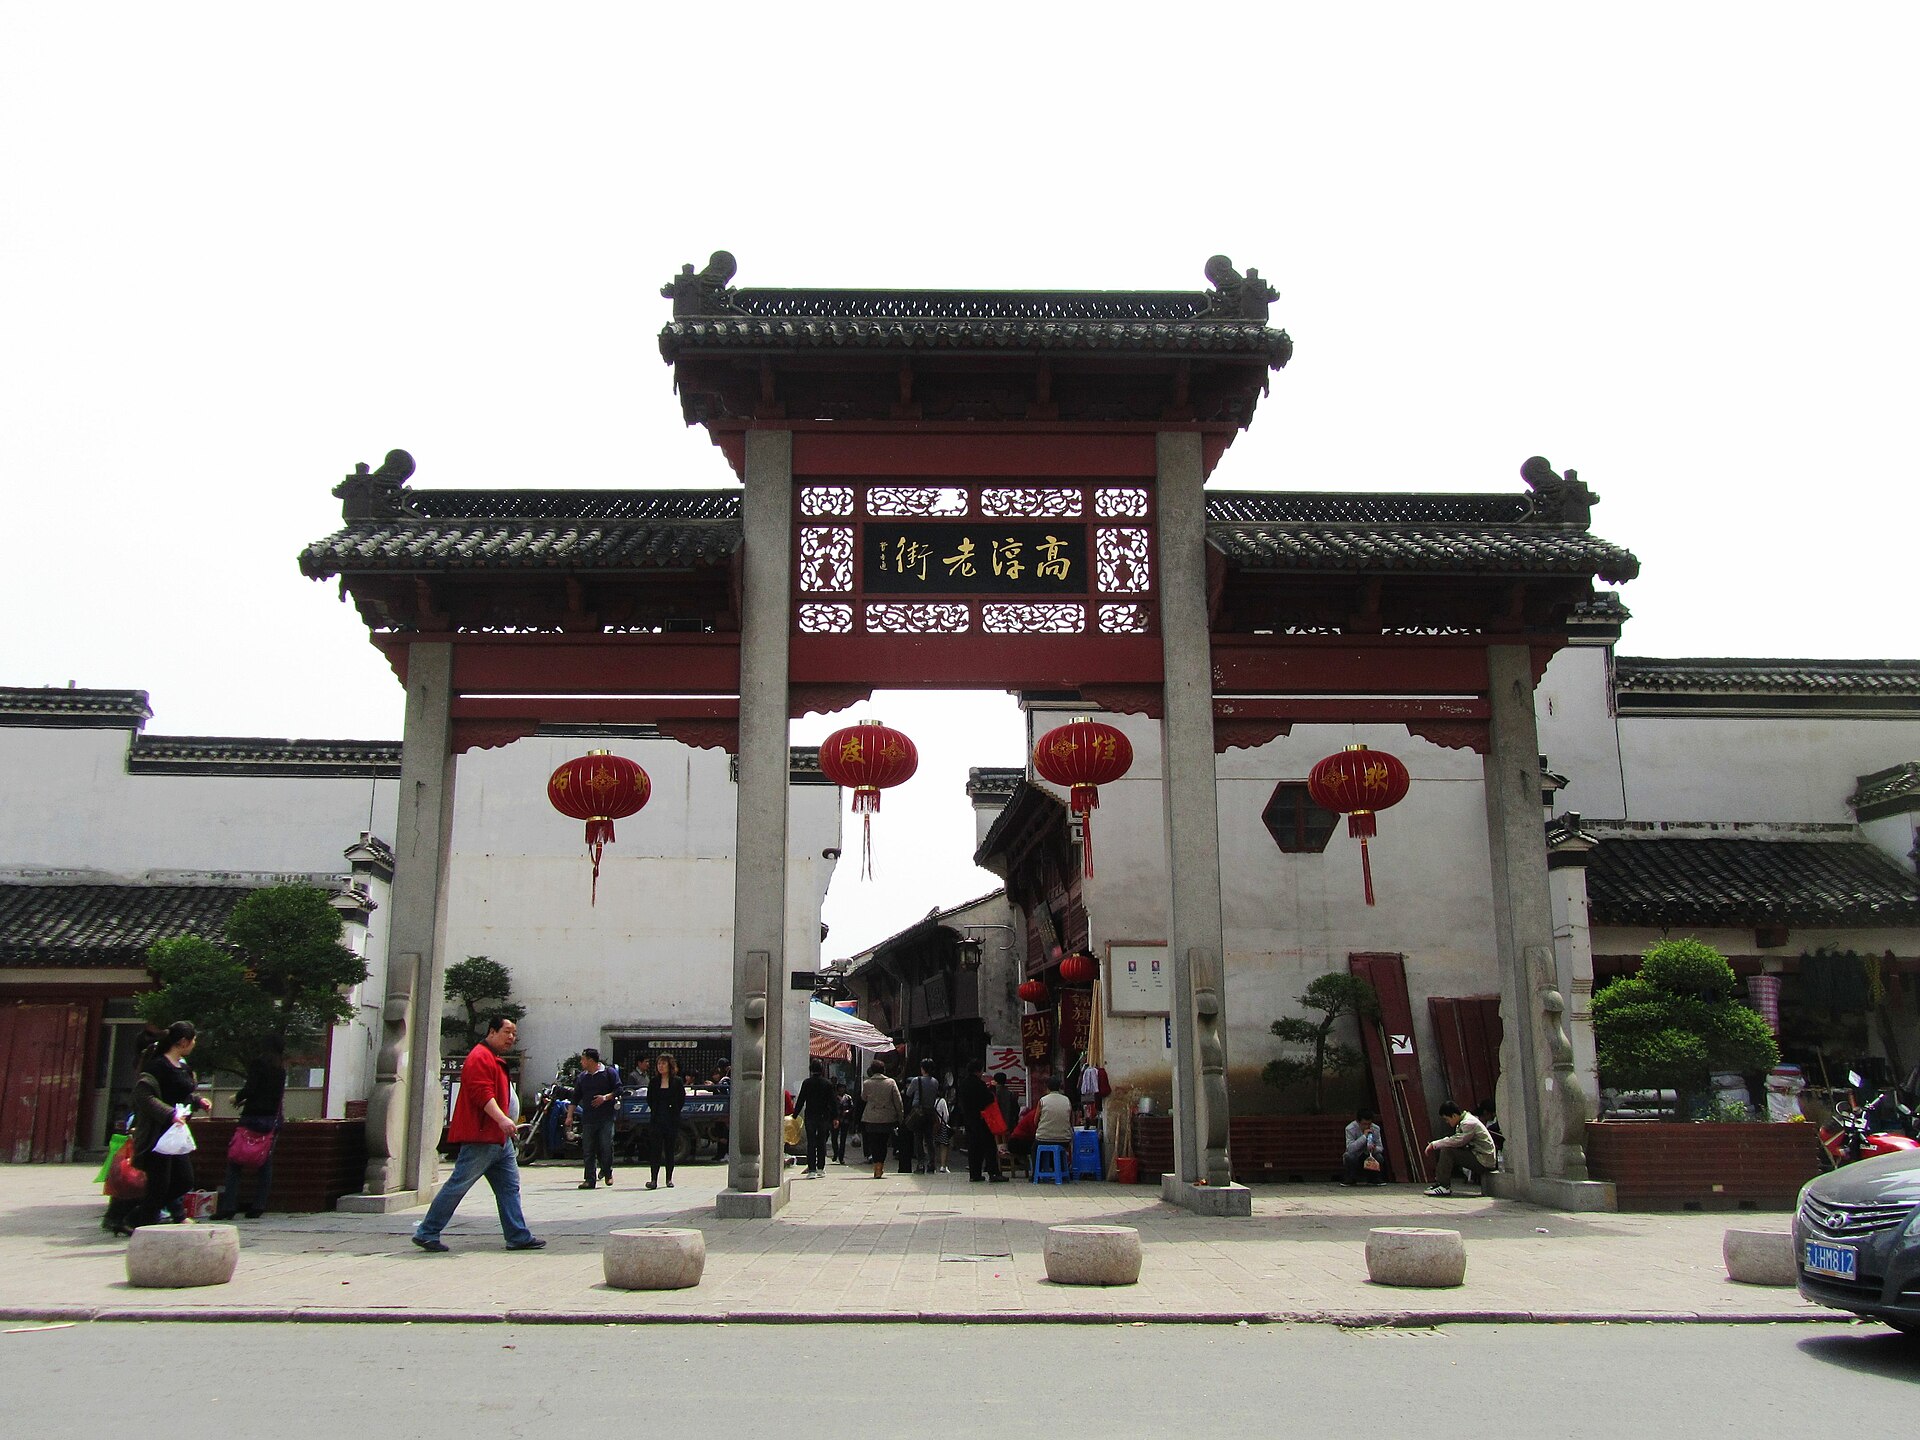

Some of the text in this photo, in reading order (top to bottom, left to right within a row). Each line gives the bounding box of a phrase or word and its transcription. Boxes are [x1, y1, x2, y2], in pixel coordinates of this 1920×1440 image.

[895, 535, 1071, 581] 高淳老街
[1023, 1016, 1048, 1060] 刻章
[697, 1103, 724, 1112] ATM
